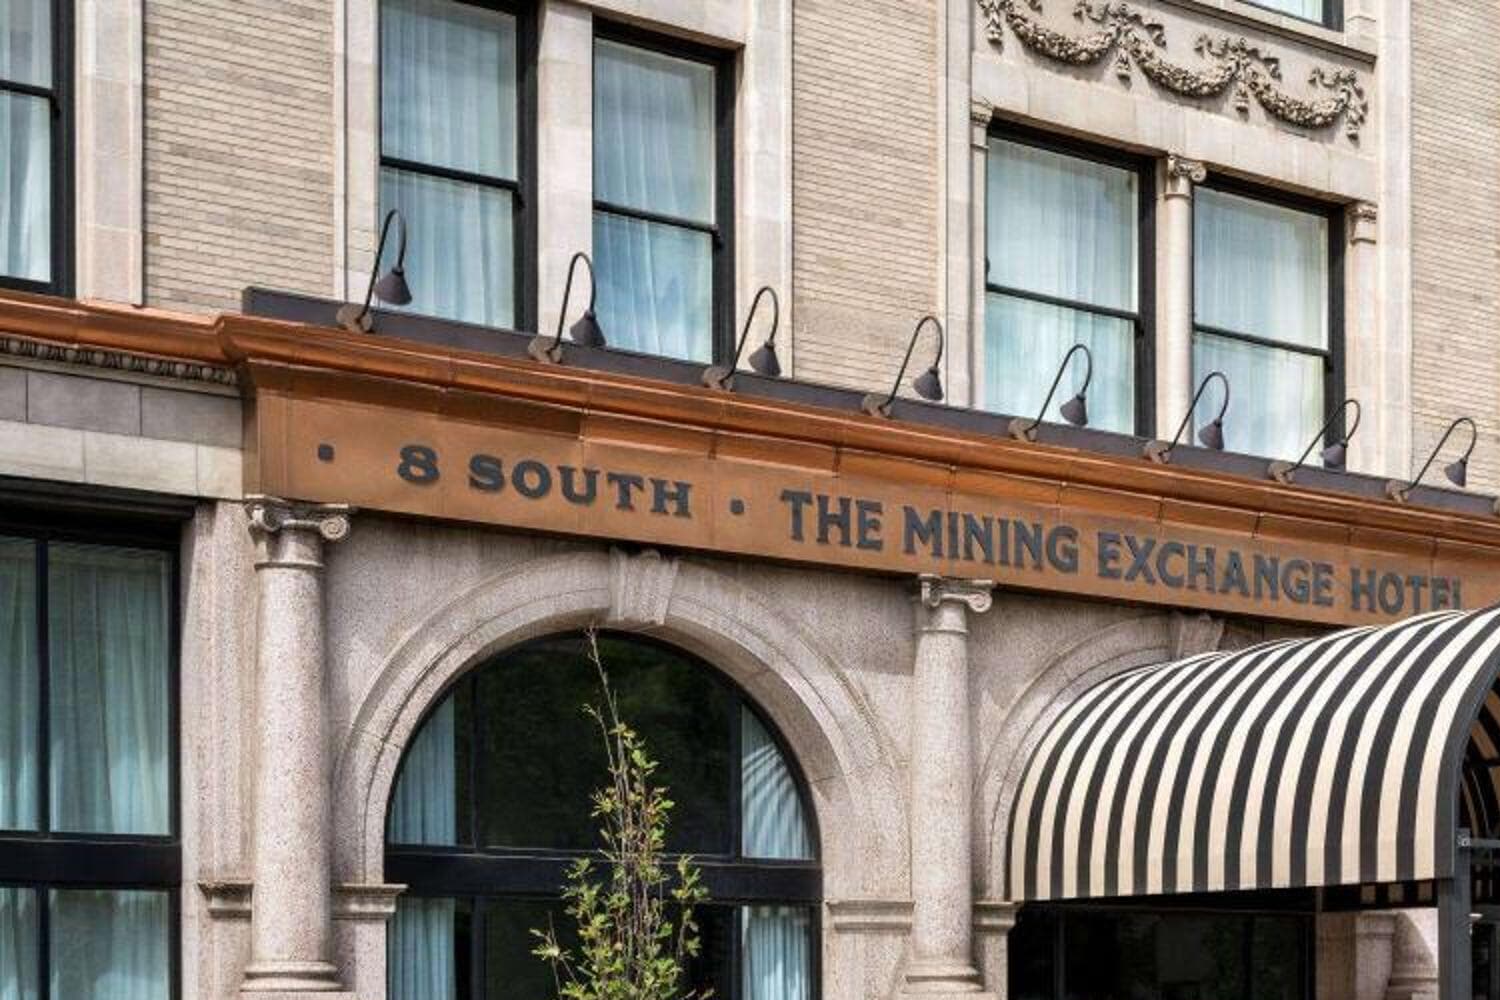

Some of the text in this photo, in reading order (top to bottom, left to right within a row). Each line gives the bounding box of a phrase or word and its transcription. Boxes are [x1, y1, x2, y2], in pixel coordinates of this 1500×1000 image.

[398, 444, 692, 517] 8 SOUTH
[780, 490, 883, 552] THE
[903, 505, 1080, 573] MINING
[1098, 532, 1334, 608] EXCHANGE
